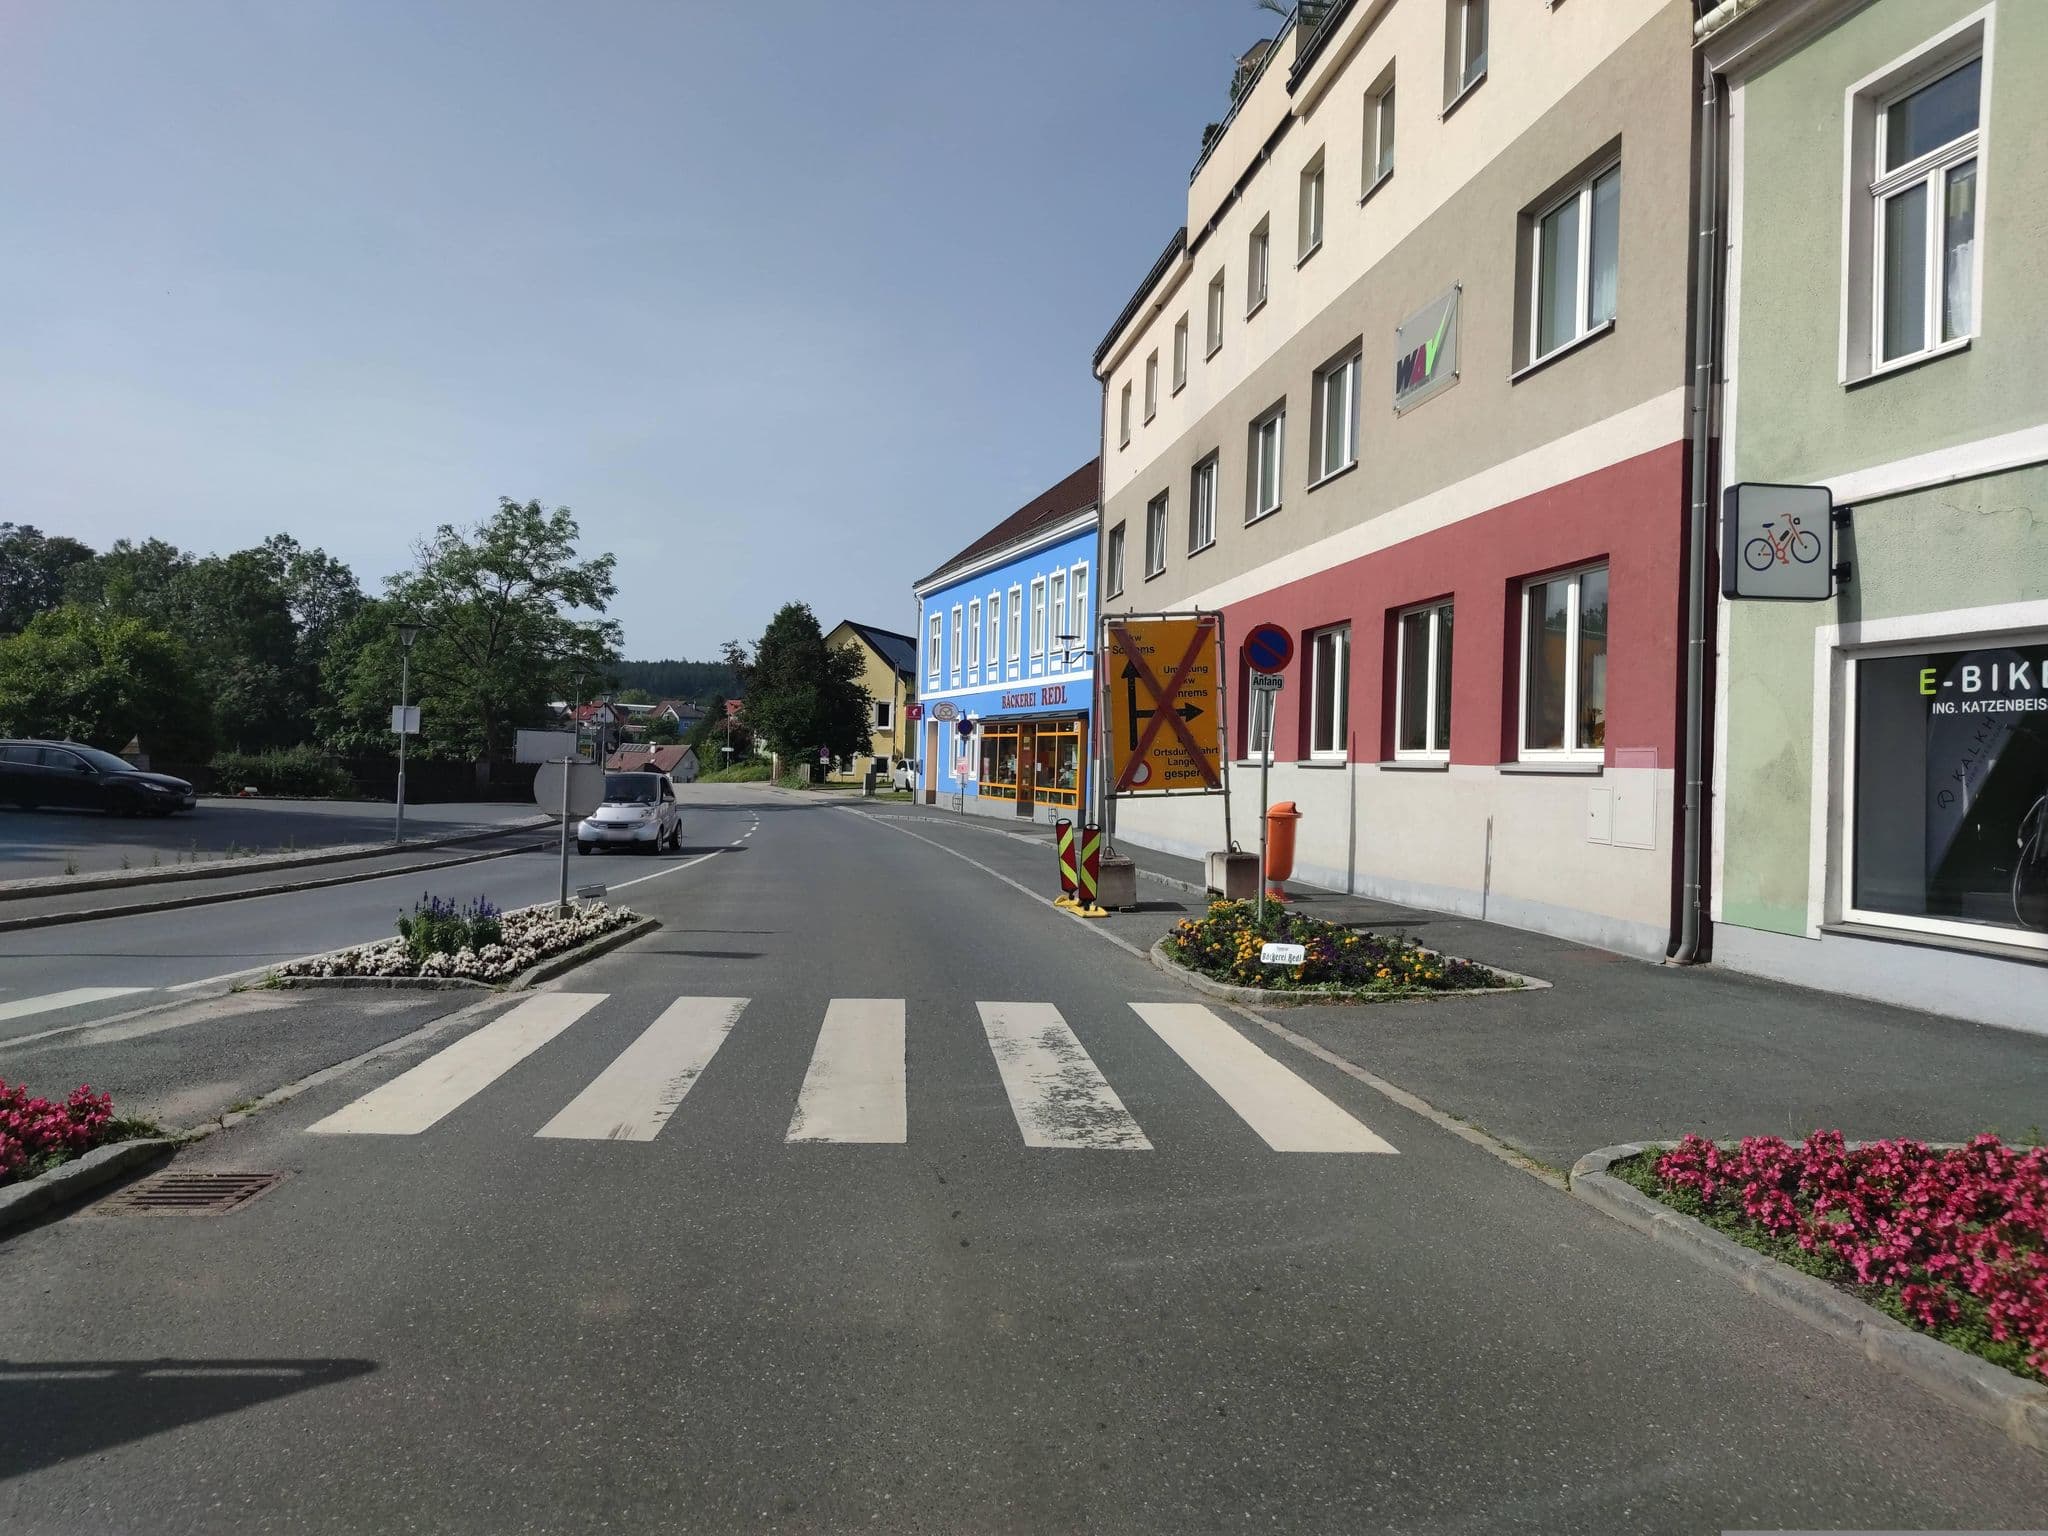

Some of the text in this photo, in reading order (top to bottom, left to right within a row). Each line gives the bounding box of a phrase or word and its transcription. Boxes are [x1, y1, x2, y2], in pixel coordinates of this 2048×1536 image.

[1163, 664, 1209, 674] Umung
[1253, 676, 1283, 689] Anfang
[1002, 685, 1068, 709] BÄCKEREI REDL
[1932, 698, 2048, 715] ING. KATZENBEIS
[1154, 747, 1219, 756] Ortsdurahrt
[1165, 770, 1202, 780] gesper
